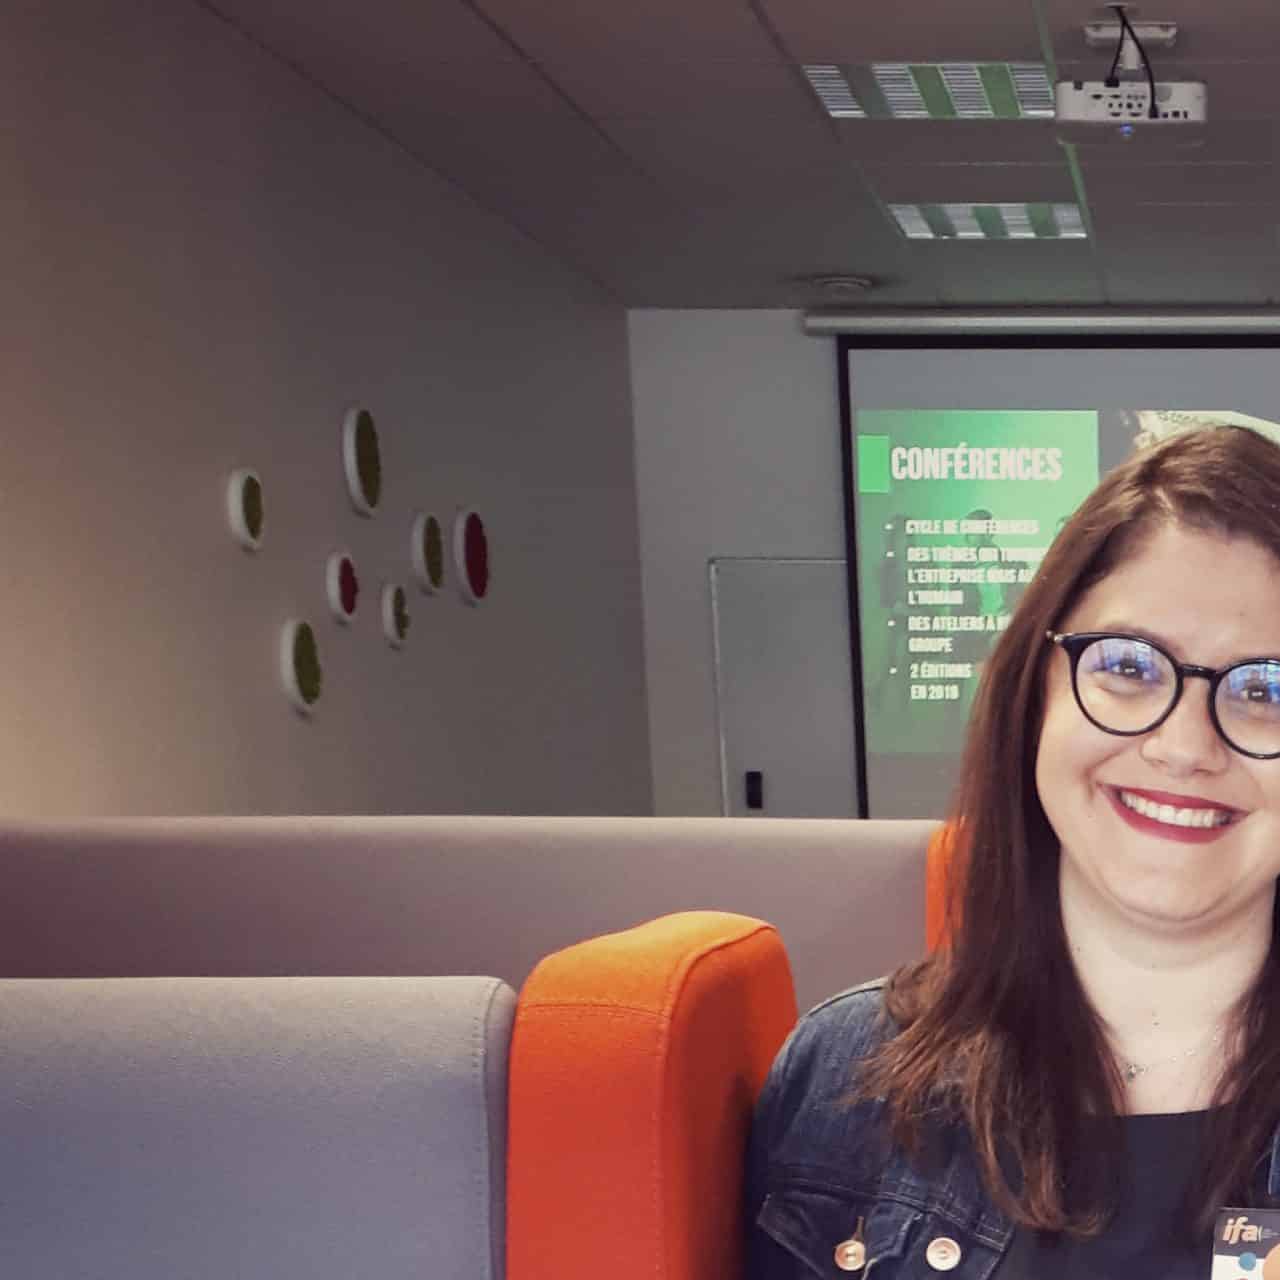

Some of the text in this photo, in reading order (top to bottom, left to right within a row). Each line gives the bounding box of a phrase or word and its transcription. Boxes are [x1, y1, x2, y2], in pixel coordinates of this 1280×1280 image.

[891, 442, 1063, 480] CONFÉRENCES
[906, 519, 941, 535] CYCLE
[908, 616, 931, 631] DES
[932, 616, 984, 631] ATELIERS
[910, 663, 919, 678] 2
[911, 685, 927, 699] EN
[1223, 1216, 1257, 1244] ifa
